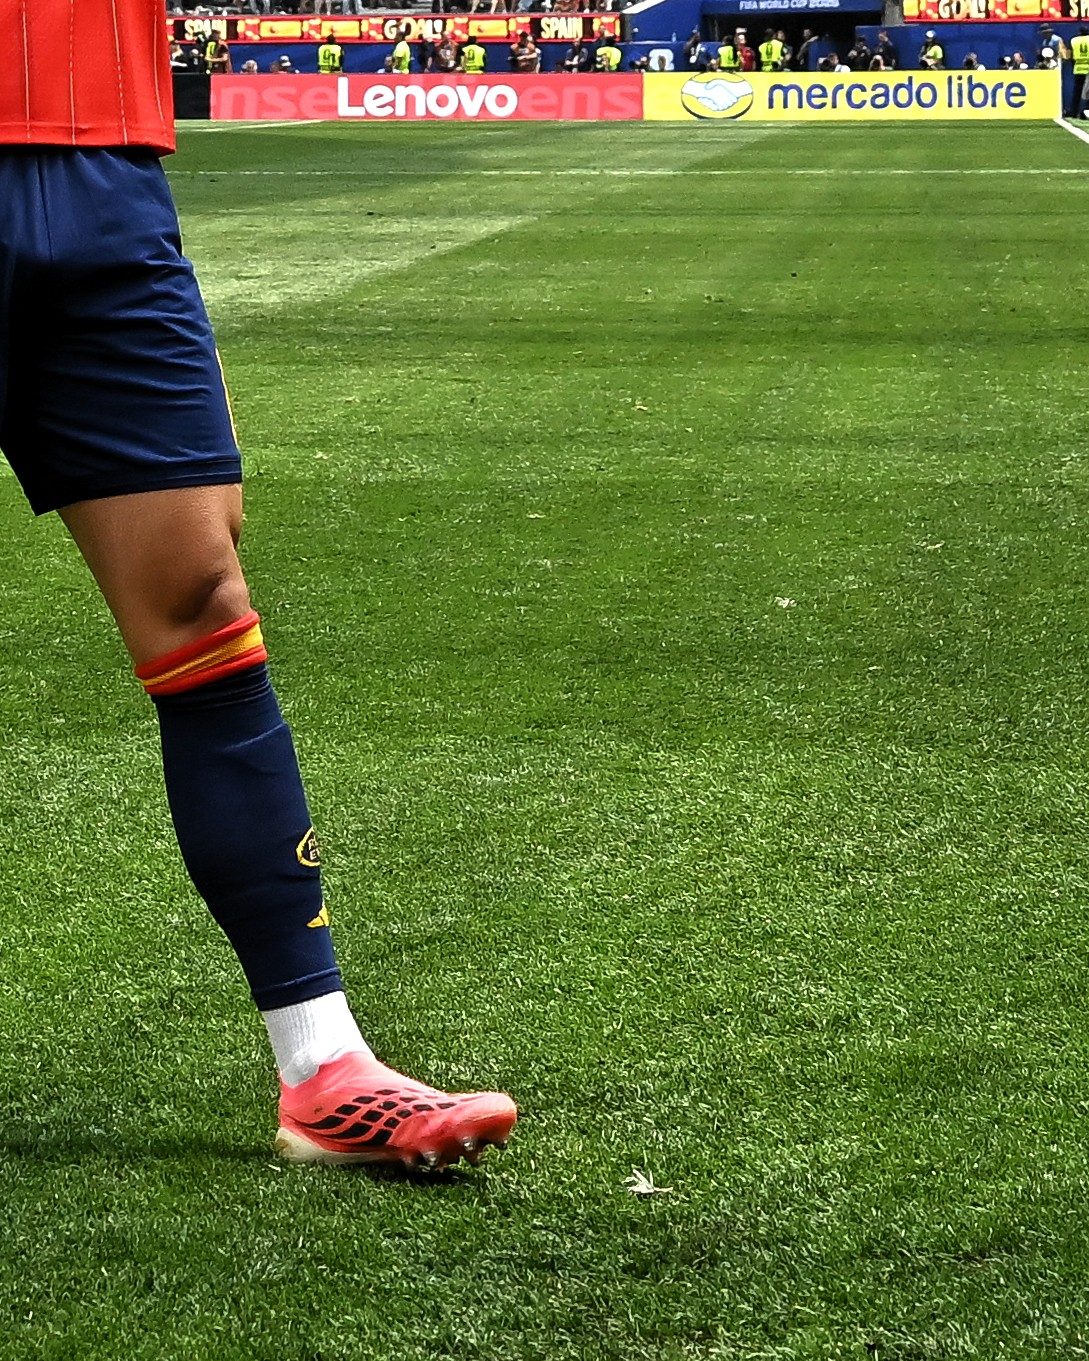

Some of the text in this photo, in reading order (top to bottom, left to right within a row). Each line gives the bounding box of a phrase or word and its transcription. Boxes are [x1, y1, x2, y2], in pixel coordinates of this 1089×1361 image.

[540, 17, 583, 39] SPAIN
[337, 76, 519, 117] Lenovo
[767, 75, 1027, 109] mercado libre
